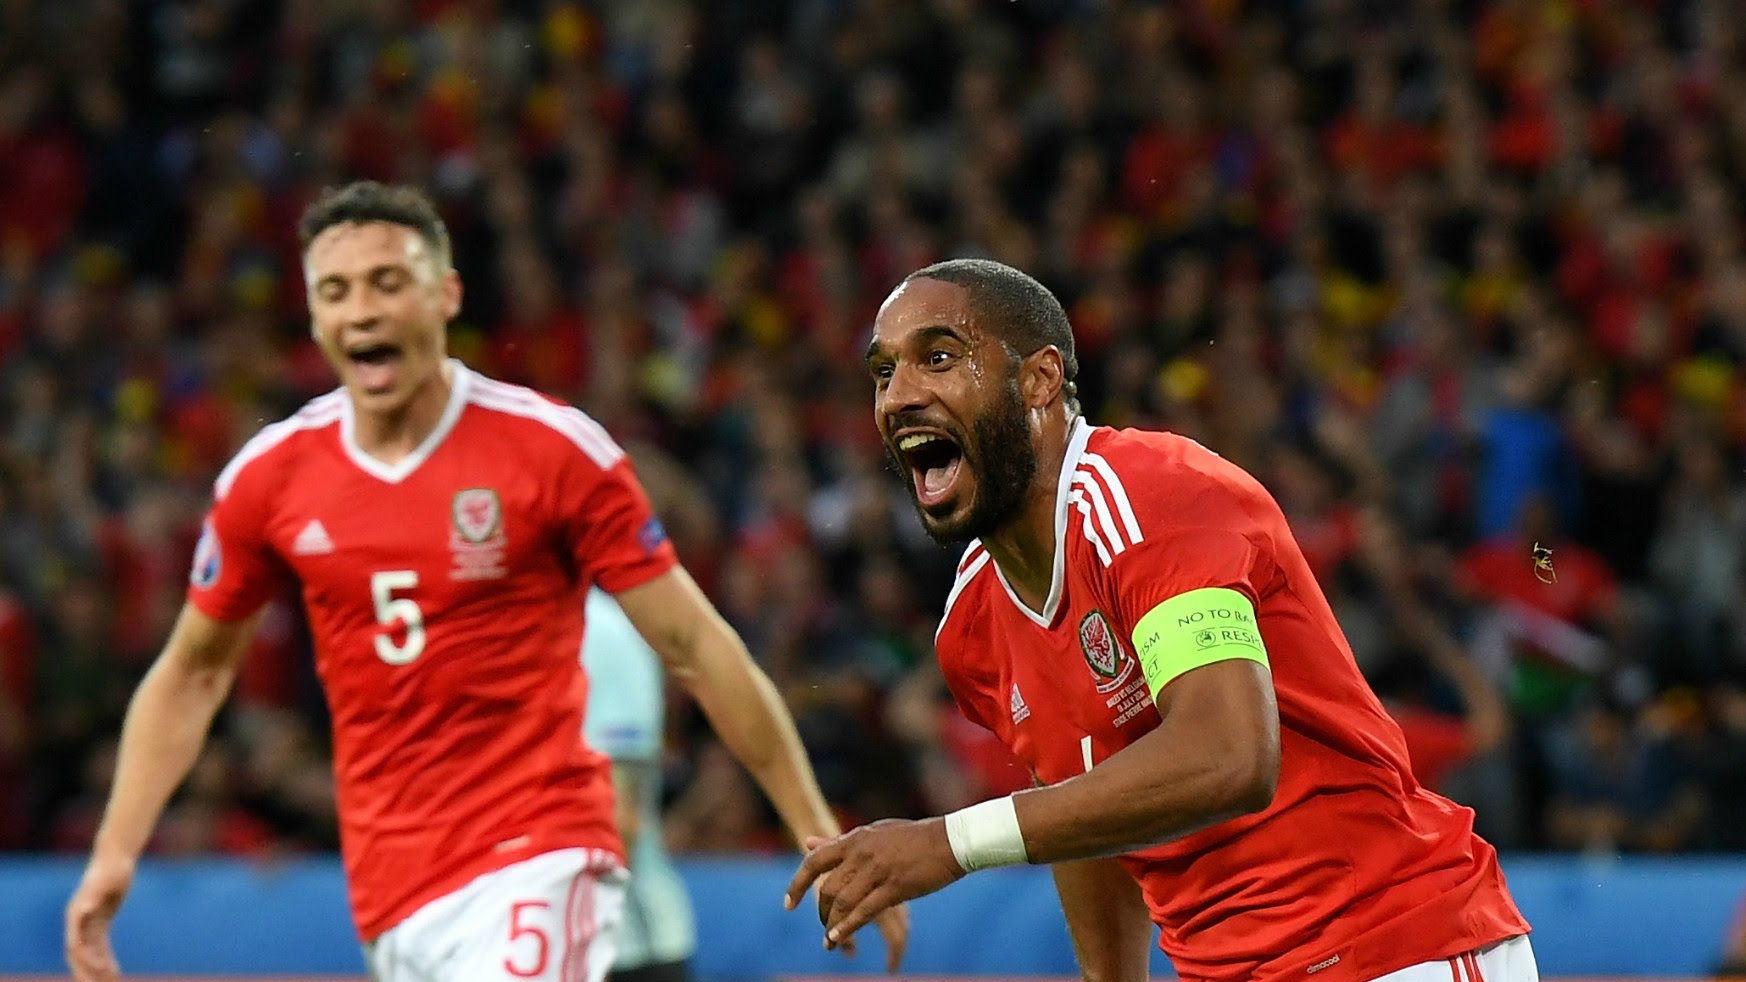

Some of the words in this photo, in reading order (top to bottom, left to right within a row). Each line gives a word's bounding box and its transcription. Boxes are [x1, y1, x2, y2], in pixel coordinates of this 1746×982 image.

[370, 569, 425, 665] 5
[1178, 612, 1204, 628] NO
[1207, 608, 1231, 619] TO
[504, 900, 550, 978] 5
